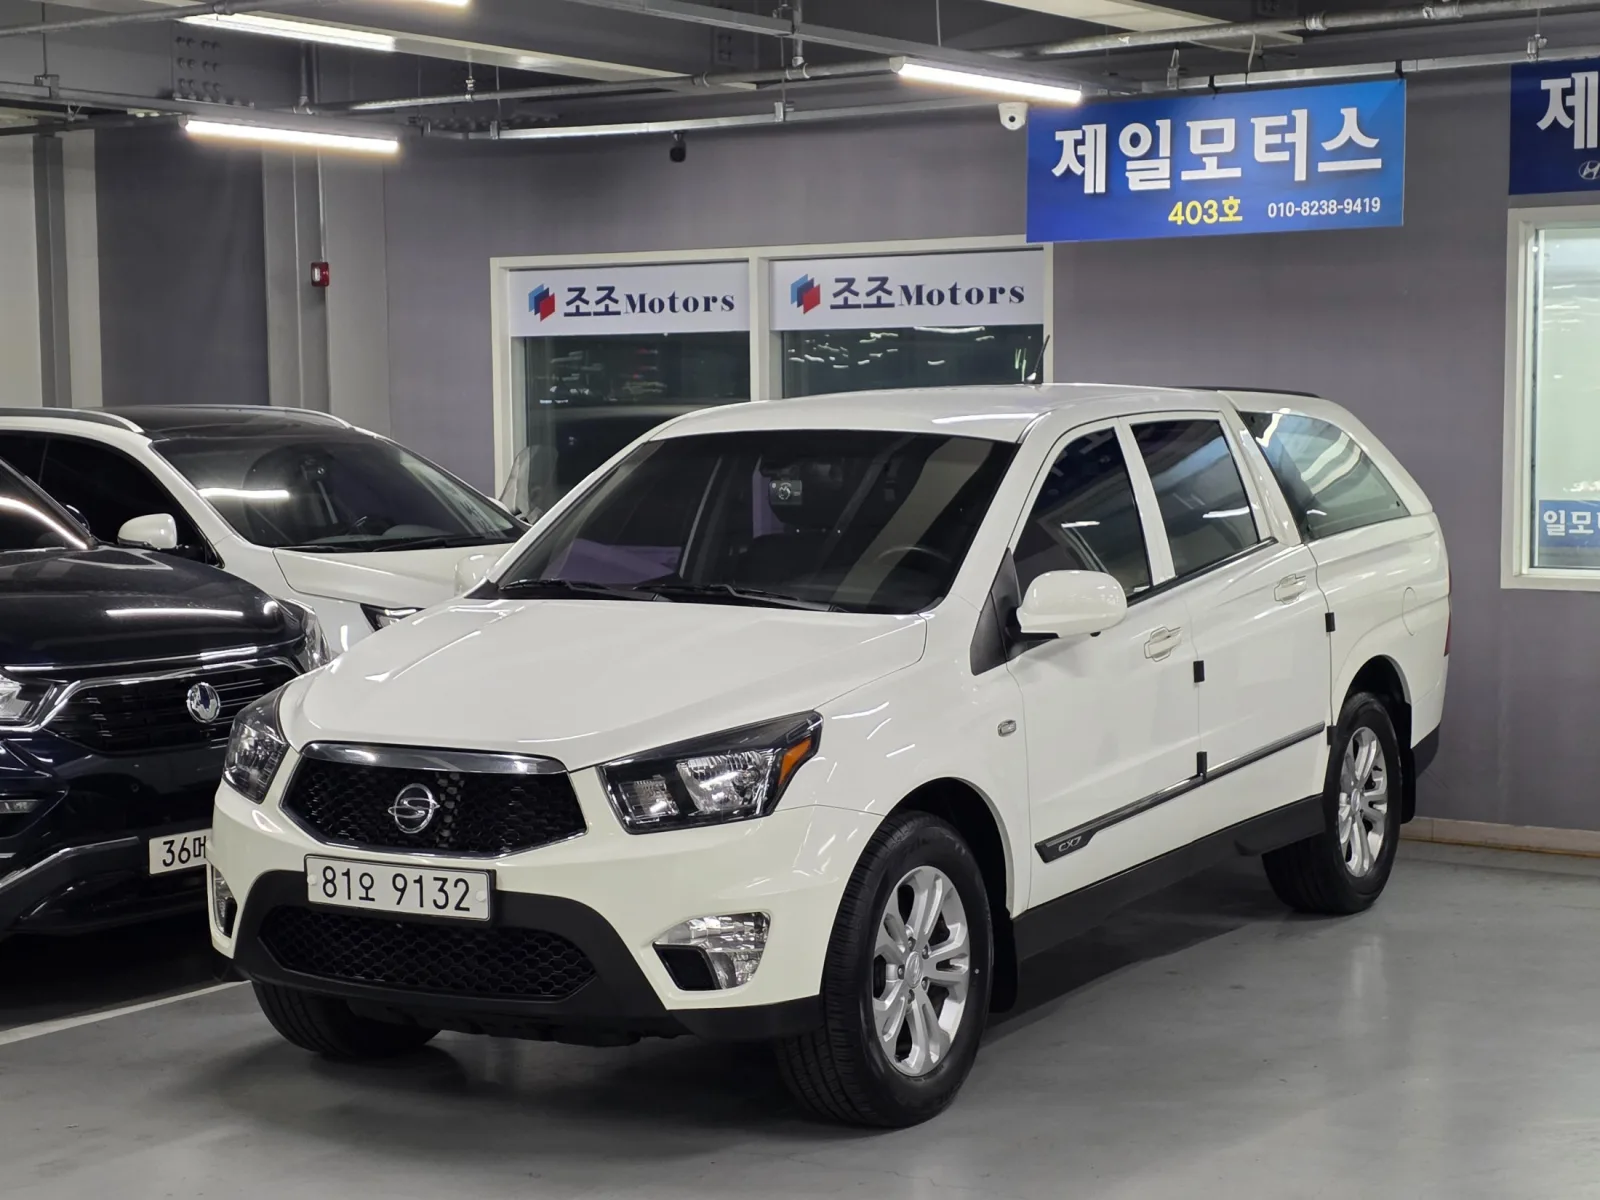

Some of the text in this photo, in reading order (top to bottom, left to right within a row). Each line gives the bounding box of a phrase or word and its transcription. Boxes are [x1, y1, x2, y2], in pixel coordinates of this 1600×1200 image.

[1051, 107, 1382, 194] 제일모터스
[1168, 196, 1381, 225] 403호 010-8238-9419
[1543, 509, 1600, 536] 일모
[1058, 835, 1082, 852] CX7
[322, 865, 471, 912] 81오 9132
